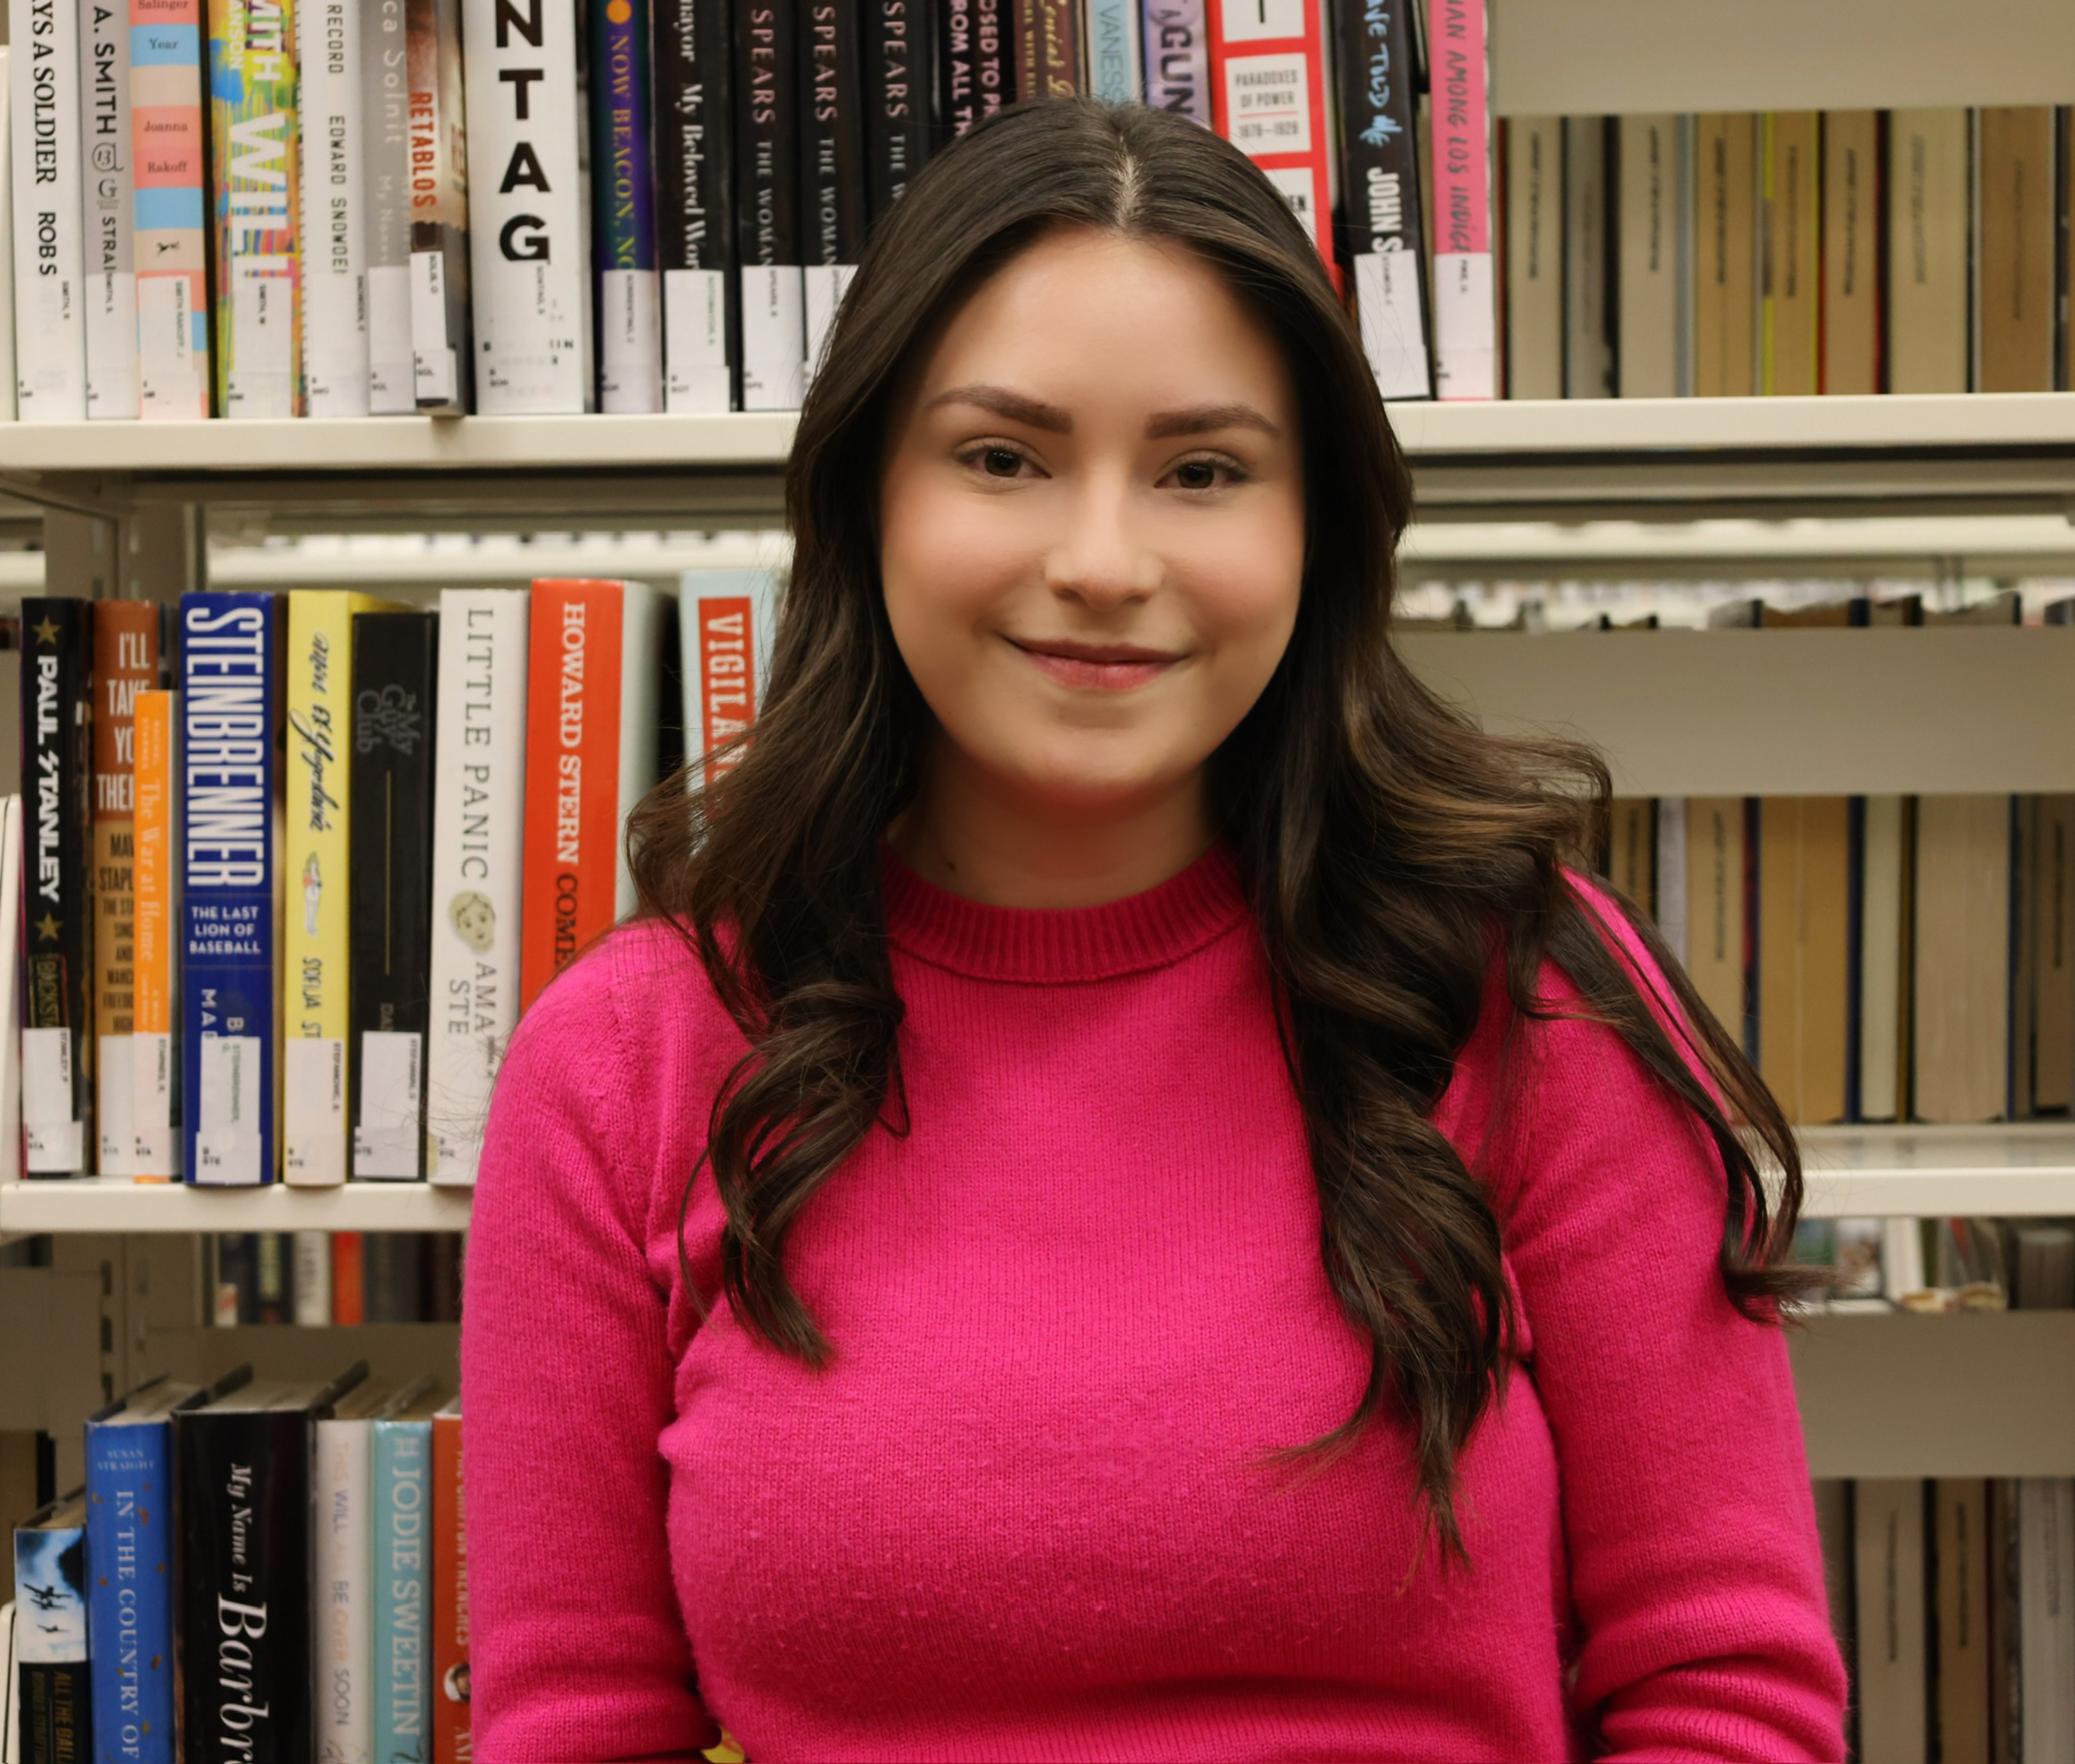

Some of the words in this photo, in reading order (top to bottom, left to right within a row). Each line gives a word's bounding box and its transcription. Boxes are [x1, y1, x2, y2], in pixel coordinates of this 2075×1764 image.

[94, 5, 113, 33] A.
[138, 0, 189, 11] Salinger
[33, 40, 54, 61] A
[149, 38, 179, 50] Year
[327, 4, 344, 74] RECORD
[610, 35, 631, 97] NOW
[812, 6, 838, 122] SPEARS
[883, 3, 908, 120] SPEARS
[94, 43, 117, 135] SMITH
[751, 9, 776, 124] SPEARS
[952, 61, 972, 101] ALL
[981, 58, 1000, 87] TO
[1235, 69, 1298, 87] PARADOXES
[1446, 50, 1469, 127] AMONG
[384, 49, 406, 143] Solnit
[674, 84, 703, 116] My
[1241, 94, 1254, 108] OF
[1257, 91, 1295, 106] POWER
[33, 67, 57, 185] SOLDIER
[143, 120, 188, 133] Joanna
[329, 116, 346, 185] EDWARD
[407, 92, 437, 208] RETABLOS
[147, 161, 189, 174] Rakoff
[612, 109, 635, 227] BEACON,
[683, 125, 704, 215] Beloved
[756, 141, 772, 177] THE
[819, 139, 835, 174] THE
[890, 136, 906, 172] THE
[1447, 136, 1469, 174] LOS
[1367, 167, 1403, 233] JOHN
[119, 633, 151, 670] I'LL
[464, 607, 494, 747] LITTLE
[559, 601, 585, 749] HOWARD
[37, 656, 58, 746] PAUL
[107, 680, 151, 717] TAK
[186, 607, 264, 886] STEINBRENNER
[140, 779, 160, 819] The
[460, 764, 491, 880] PANIC
[556, 755, 582, 865] STERN
[38, 749, 60, 904] STANLEY
[141, 826, 161, 867] War
[141, 874, 157, 892] at
[141, 901, 161, 962] Home
[191, 906, 218, 920] THE
[222, 906, 259, 920] LAST
[195, 923, 231, 937] LION
[234, 923, 255, 937] OF
[189, 940, 261, 954] BASEBALL
[449, 979, 470, 1034] STE
[475, 962, 497, 1032] AMA
[117, 1491, 134, 1517] IN
[226, 1463, 252, 1498] My
[231, 1503, 252, 1565] Name
[333, 1489, 349, 1535] WILL
[391, 1467, 421, 1571] JODIE
[117, 1526, 136, 1580] THE
[232, 1572, 254, 1593] Is
[332, 1580, 350, 1603] BE
[118, 1588, 138, 1716] COUNTRY
[218, 1593, 269, 1764] Barbr
[391, 1580, 421, 1736] SWEETIN
[335, 1668, 350, 1727] SOON
[121, 1724, 140, 1759] OF
